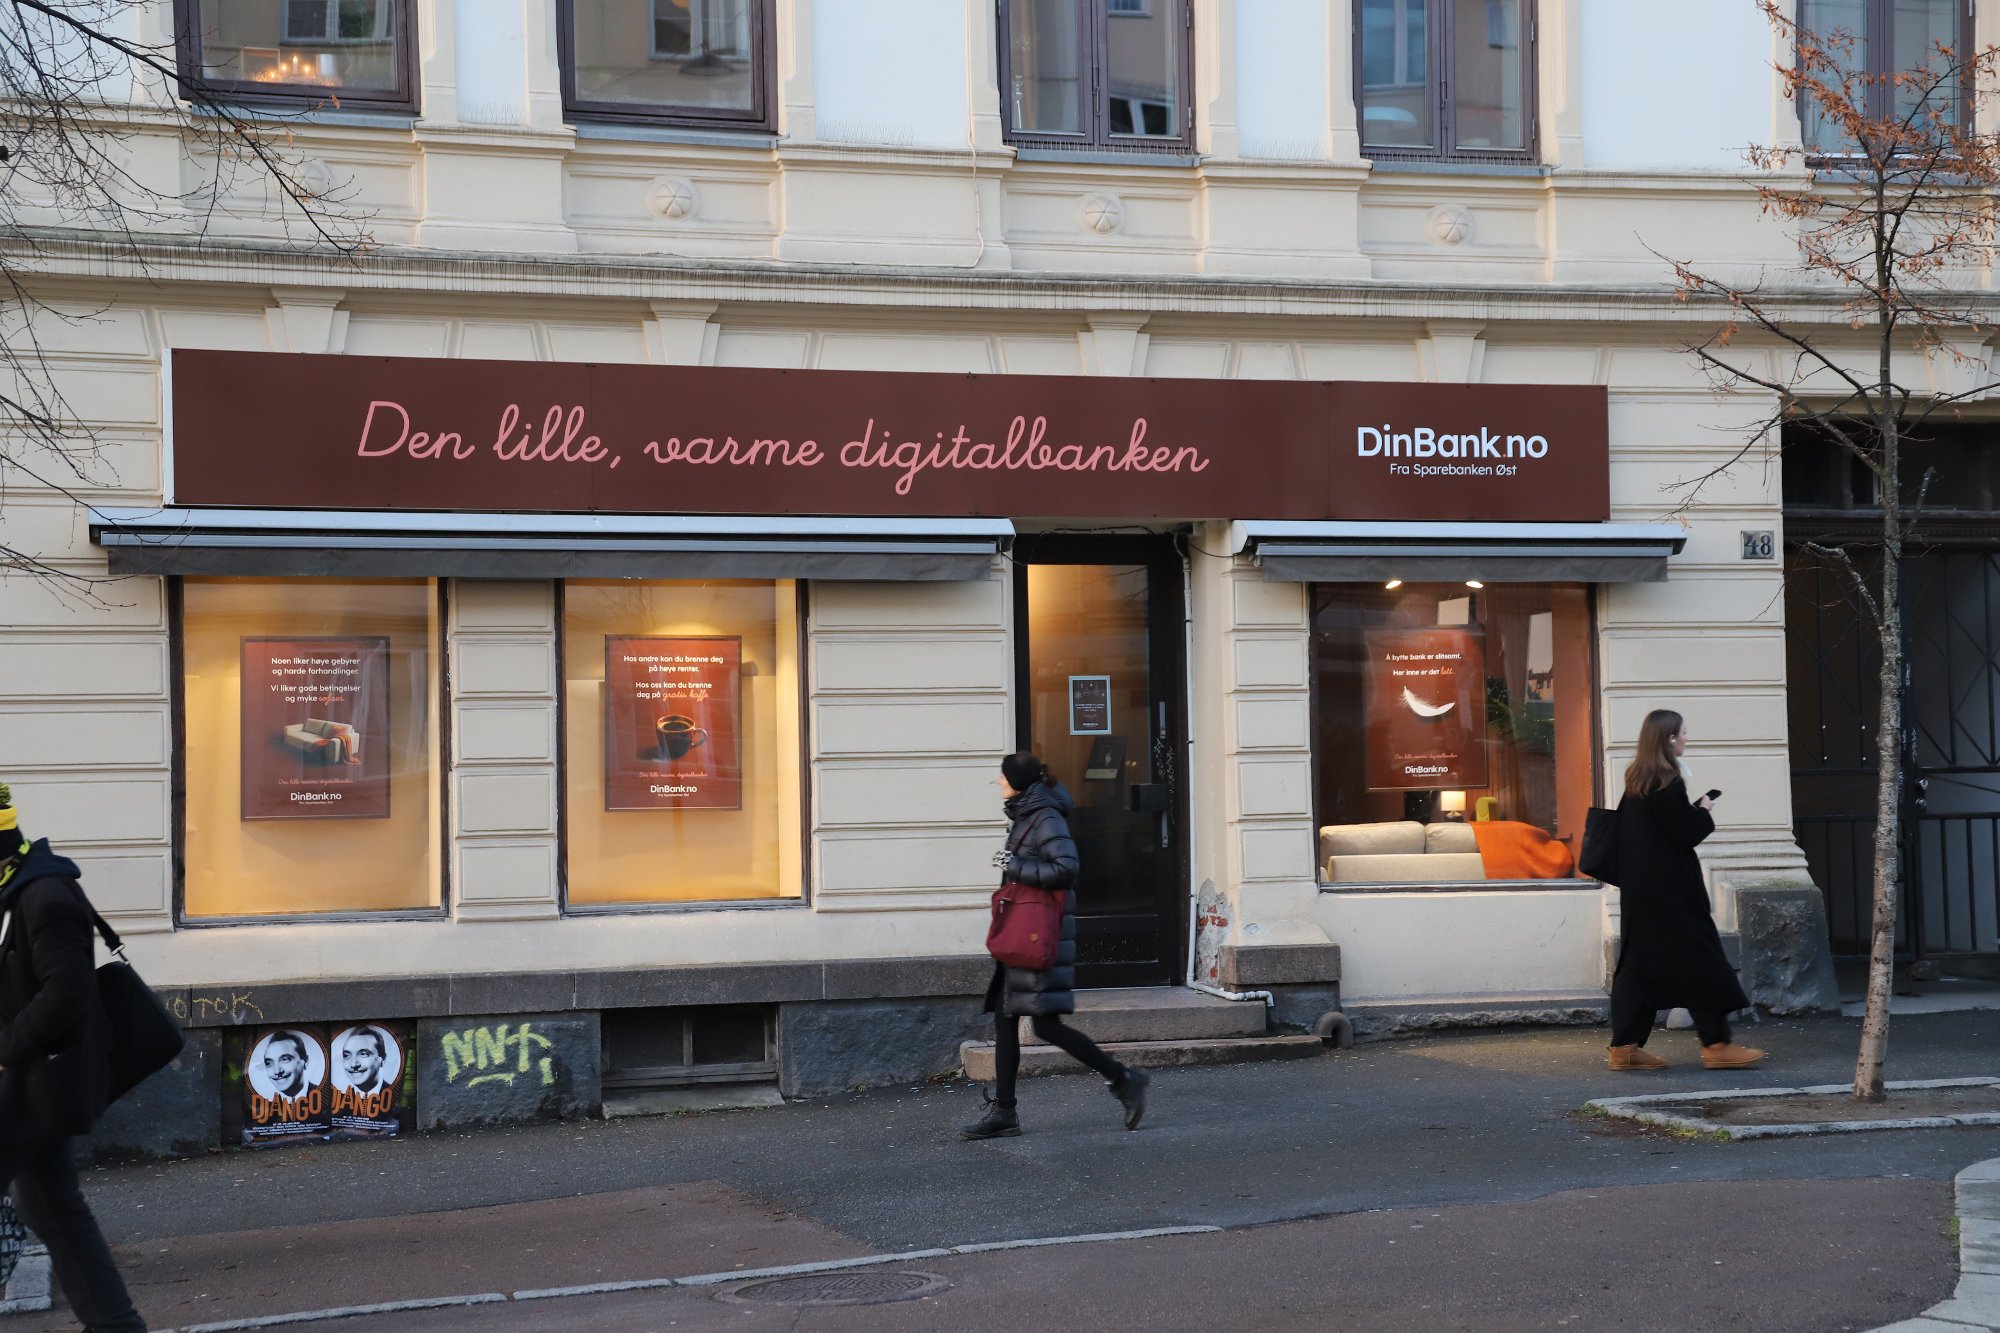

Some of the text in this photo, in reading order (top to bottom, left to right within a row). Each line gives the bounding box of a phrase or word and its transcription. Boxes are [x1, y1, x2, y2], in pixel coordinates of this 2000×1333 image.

[1357, 423, 1549, 459] DinBank.no
[357, 400, 1210, 496] Den lille, varme digitalbanken
[1389, 463, 1518, 478] Fra Sparebanken Øst
[1744, 535, 1771, 556] 48
[271, 657, 360, 666] Noen liker høye gebyrer
[710, 656, 724, 664] deg
[272, 668, 282, 676] og
[648, 665, 658, 673] på
[298, 685, 318, 693] gode
[319, 685, 361, 694] betingelser
[297, 695, 318, 703] myke
[636, 691, 650, 699] deg
[652, 691, 661, 699] på
[251, 1088, 322, 1124] DJANGO
